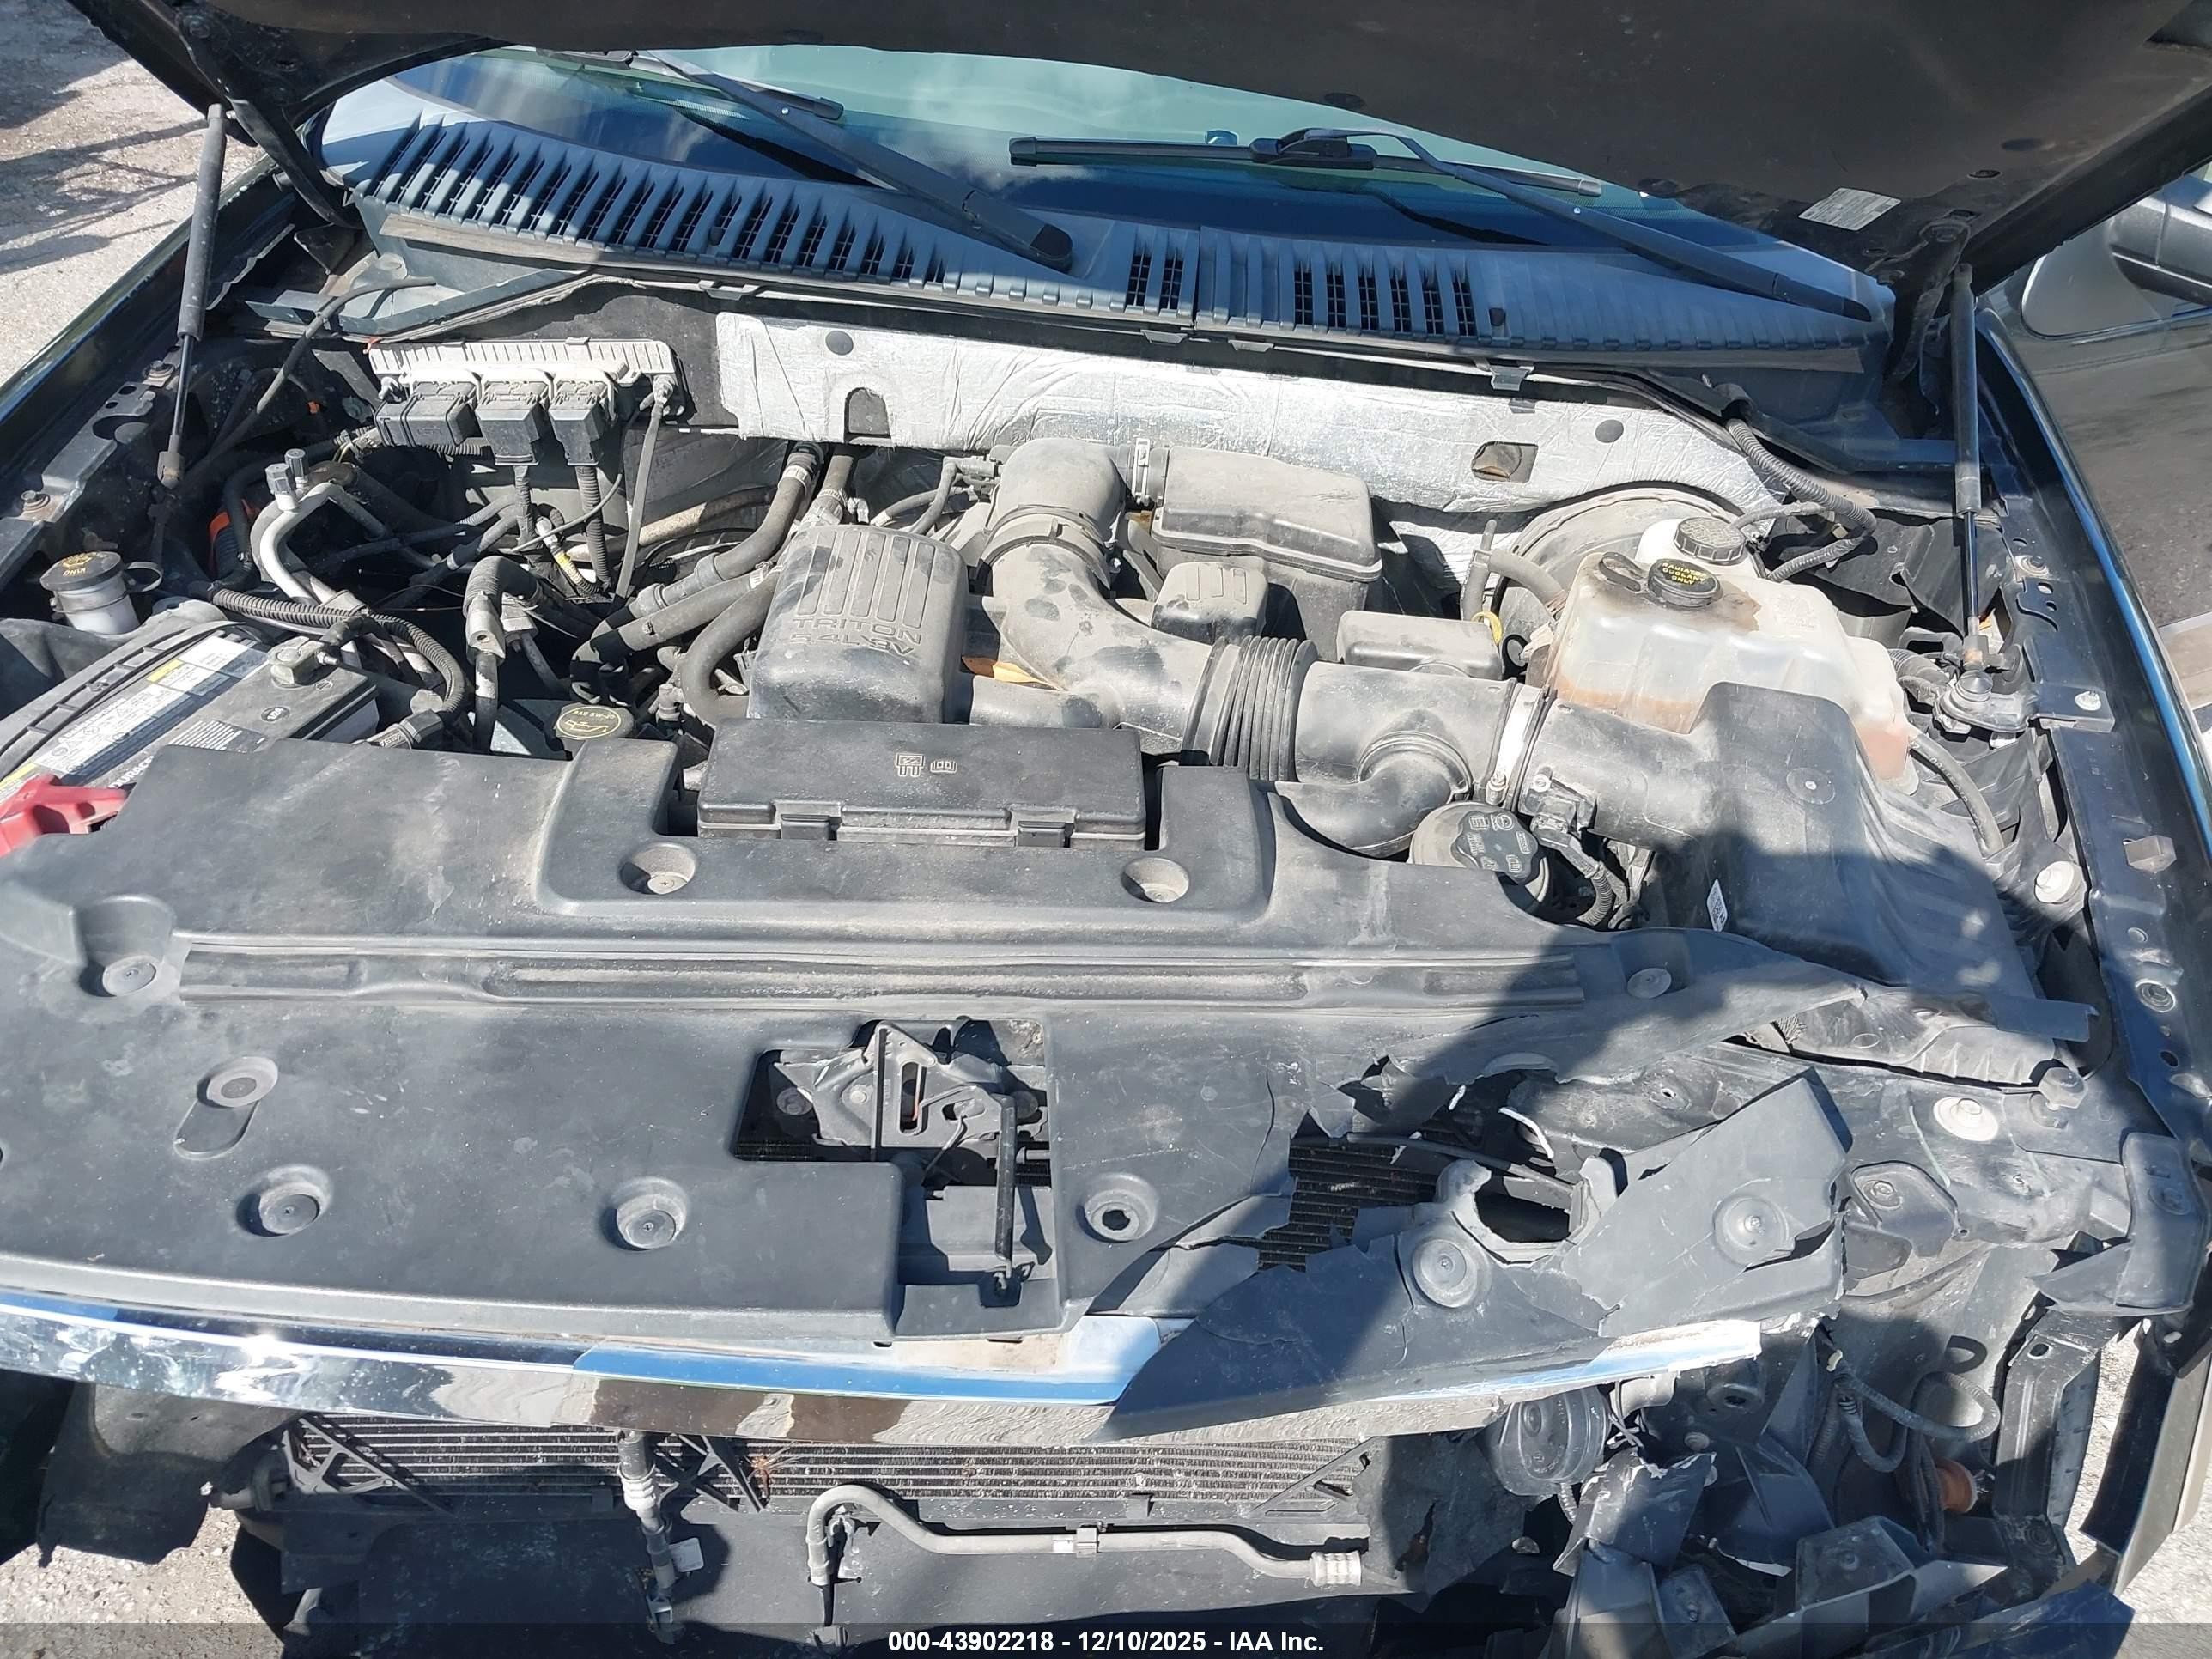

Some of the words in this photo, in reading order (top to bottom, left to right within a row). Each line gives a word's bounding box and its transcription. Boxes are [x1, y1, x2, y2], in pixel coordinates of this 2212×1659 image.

[1662, 568, 1705, 582] COOLANT
[1671, 575, 1695, 585] ONLY
[793, 617, 921, 645] TRITON
[790, 633, 860, 646] 5.4L
[589, 711, 616, 720] 5W-20
